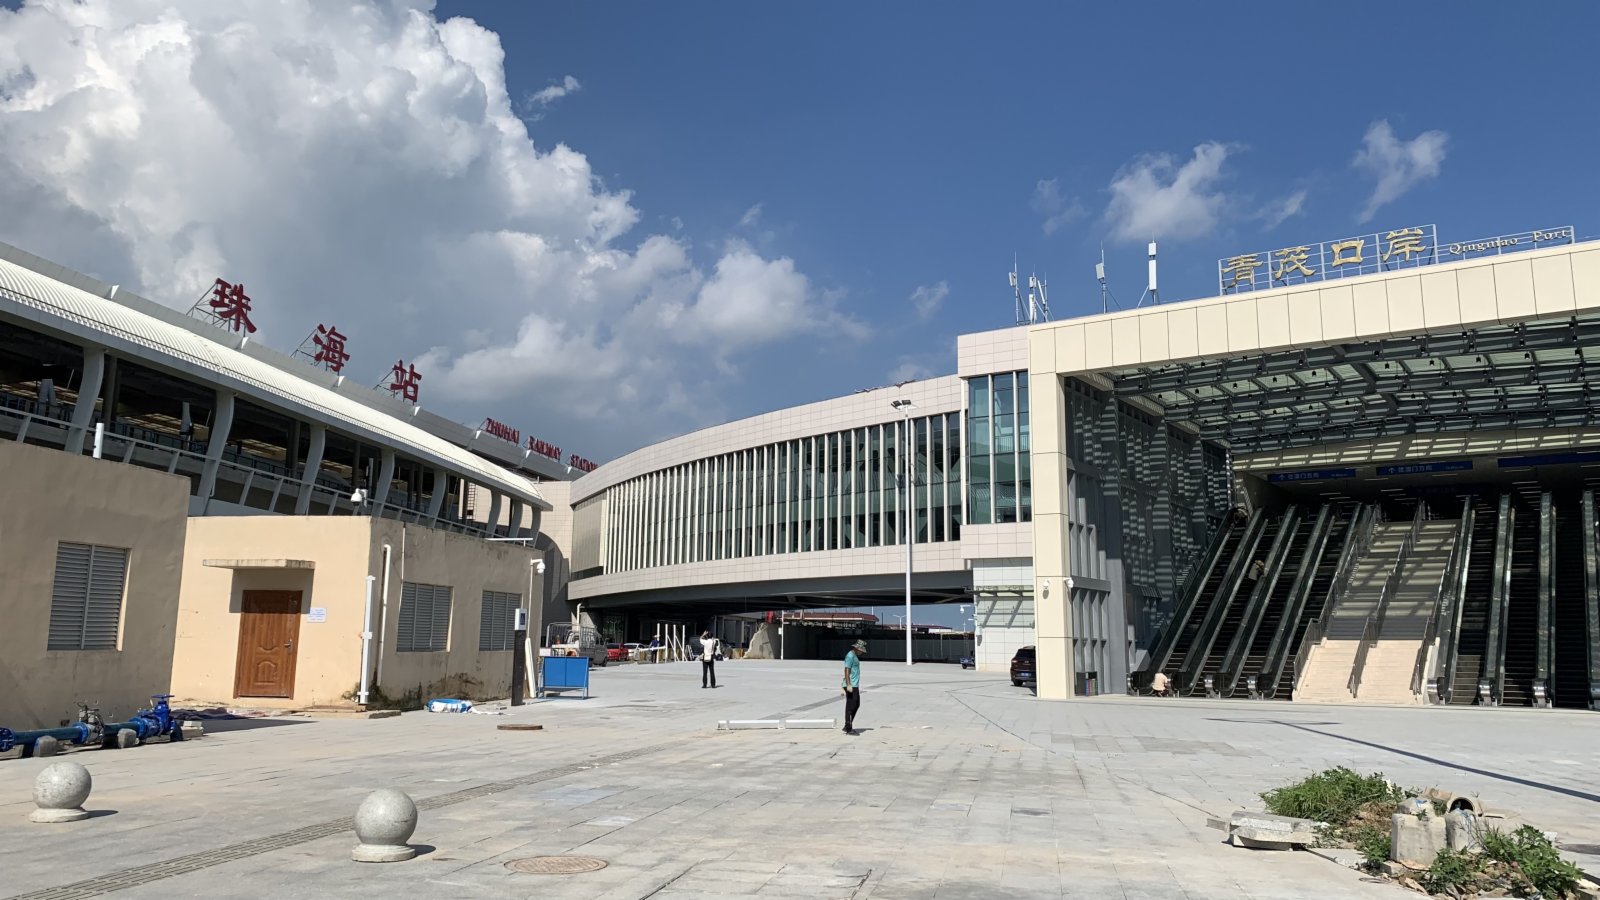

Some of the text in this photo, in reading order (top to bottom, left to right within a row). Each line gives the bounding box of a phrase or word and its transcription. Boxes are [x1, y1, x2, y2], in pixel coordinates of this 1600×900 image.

[1222, 228, 1427, 288] 青茂口岸
[1449, 229, 1568, 256] Qingmao Port
[209, 277, 422, 403] 珠海站
[485, 418, 520, 444] ZHUHAI
[528, 436, 563, 461] RAILWAY
